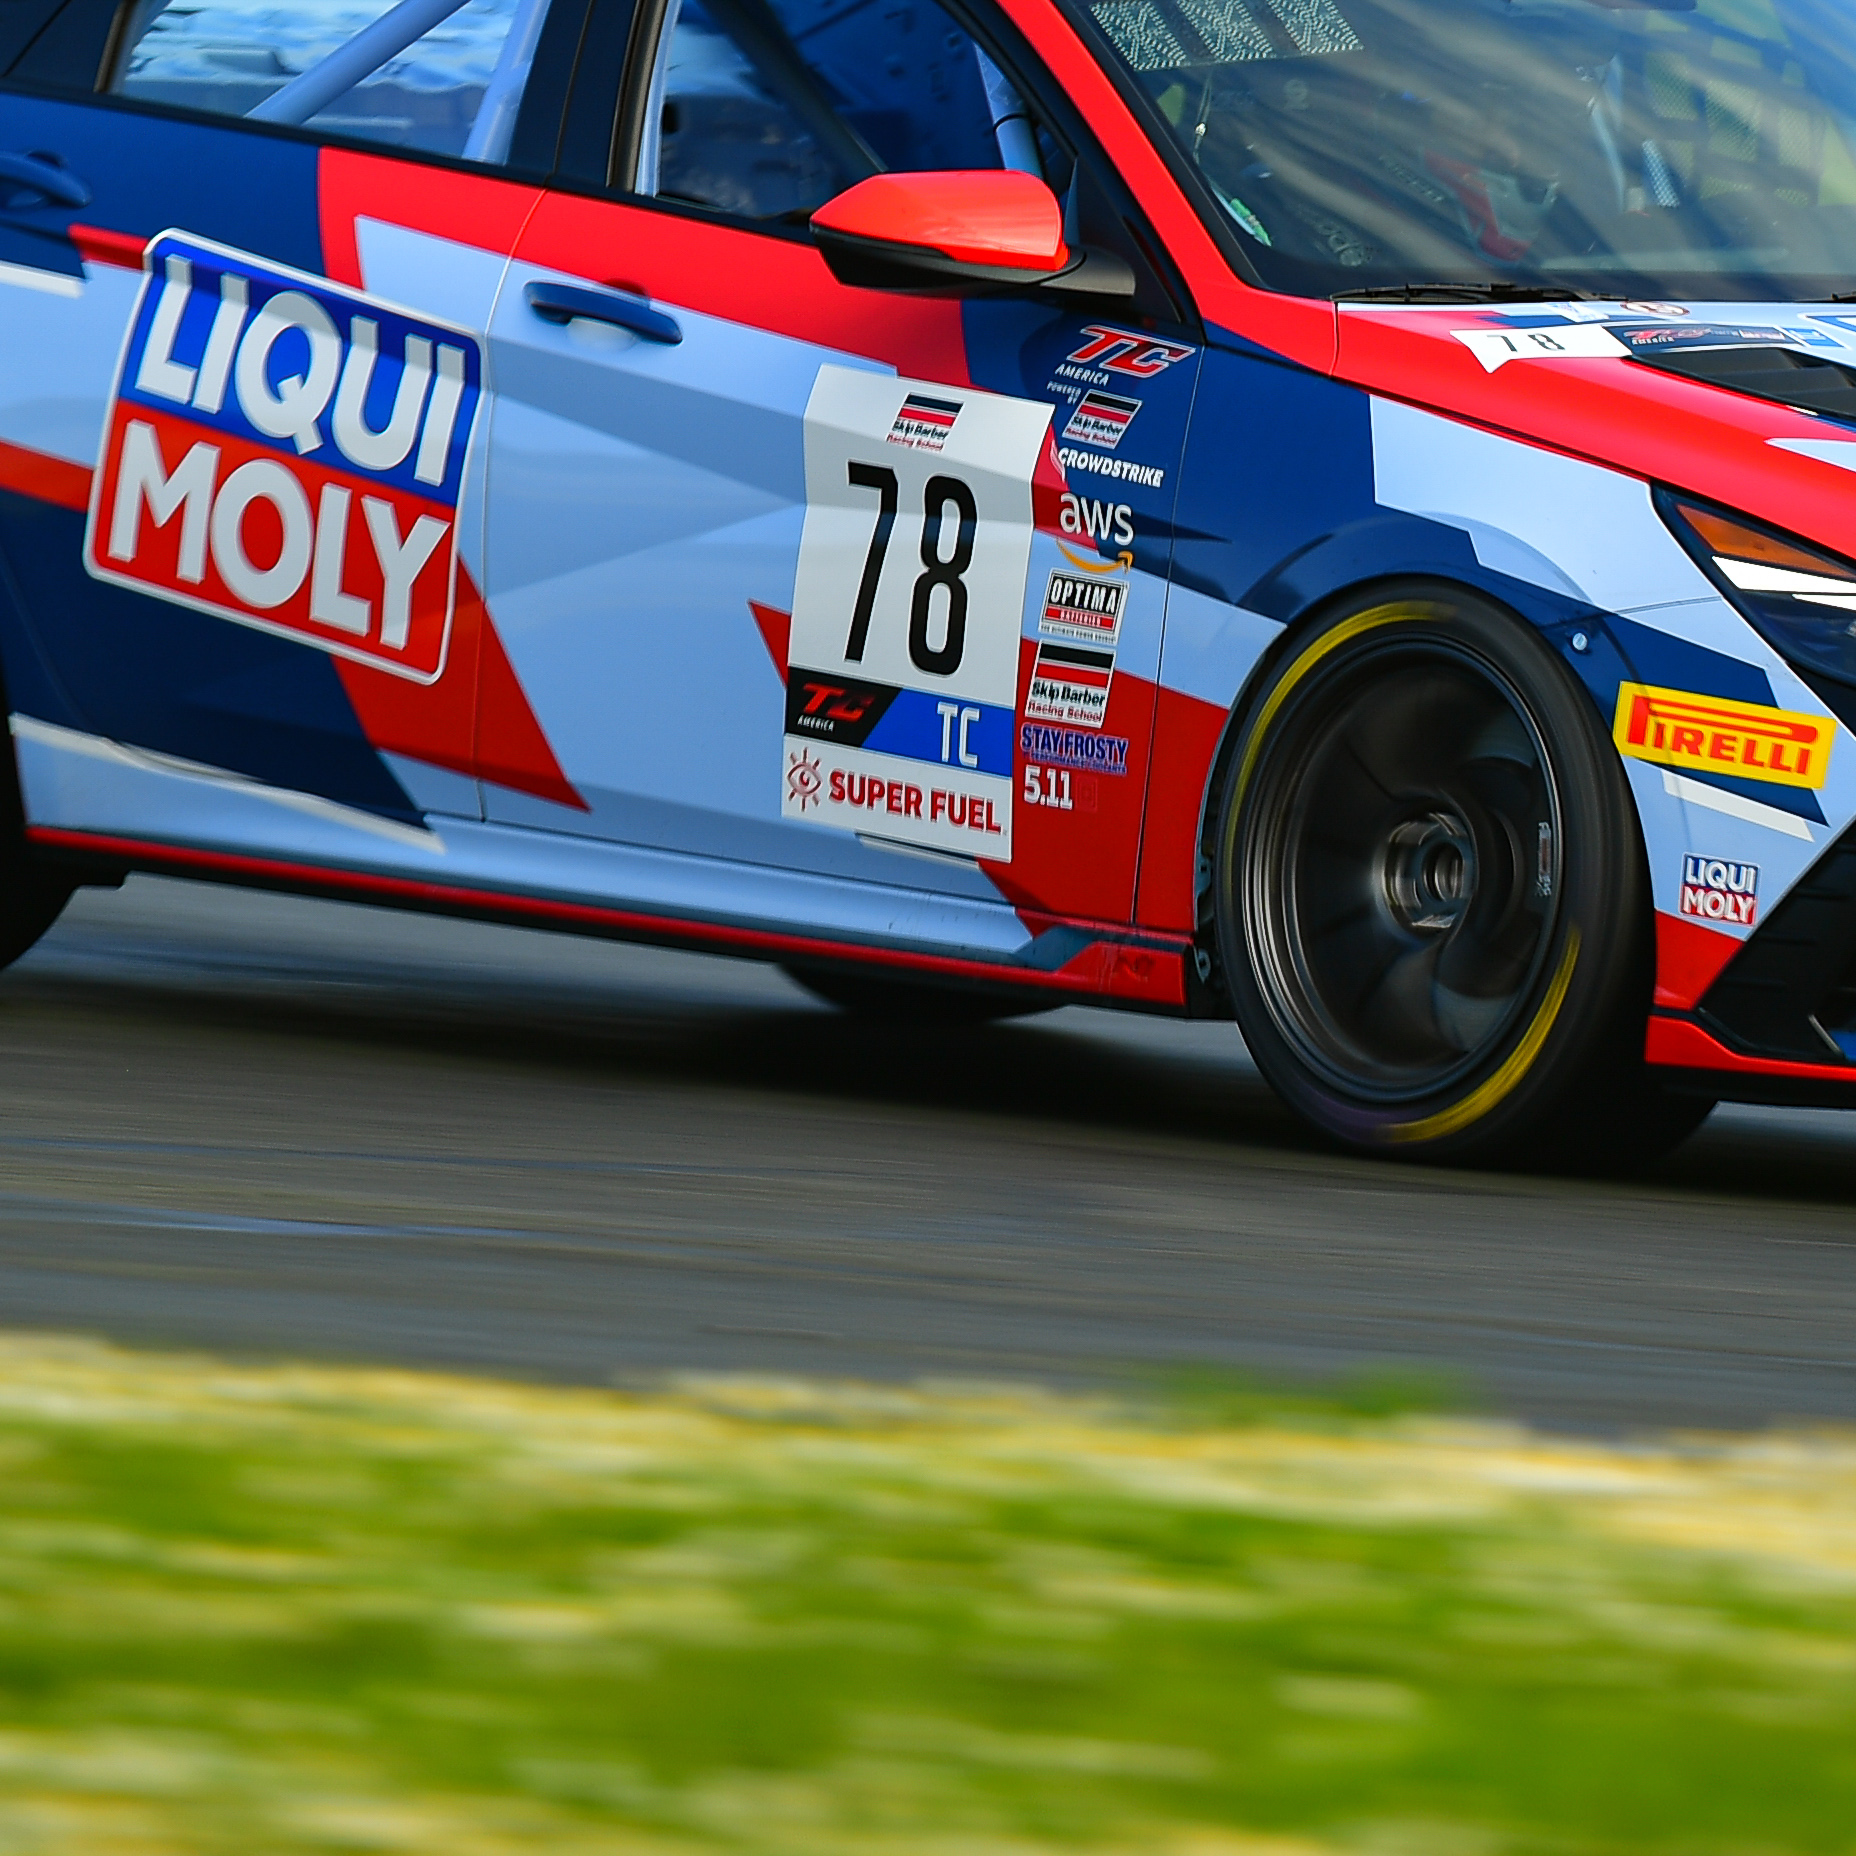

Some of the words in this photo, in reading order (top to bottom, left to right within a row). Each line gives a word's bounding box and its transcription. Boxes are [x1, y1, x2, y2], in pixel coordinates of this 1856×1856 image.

[135, 253, 466, 487] LIQUI
[1054, 363, 1110, 386] AMERICA
[1066, 324, 1197, 379] TC
[1058, 447, 1164, 488] CROWDSTRIKE
[108, 418, 451, 651] MOLY
[1059, 491, 1135, 546] aws
[843, 459, 978, 679] 78
[1050, 578, 1117, 614] OPTIMA
[797, 715, 836, 733] AMERICA
[937, 701, 981, 768] TC
[1021, 725, 1062, 753] STAY
[1064, 731, 1128, 764] FROSTY
[1627, 694, 1819, 776] PIRELLI
[829, 768, 923, 821] SUPER
[930, 788, 1002, 835] FUEL
[1024, 764, 1073, 810] 5.11
[1685, 853, 1757, 896] LIQUI
[1681, 884, 1756, 925] MOLY
